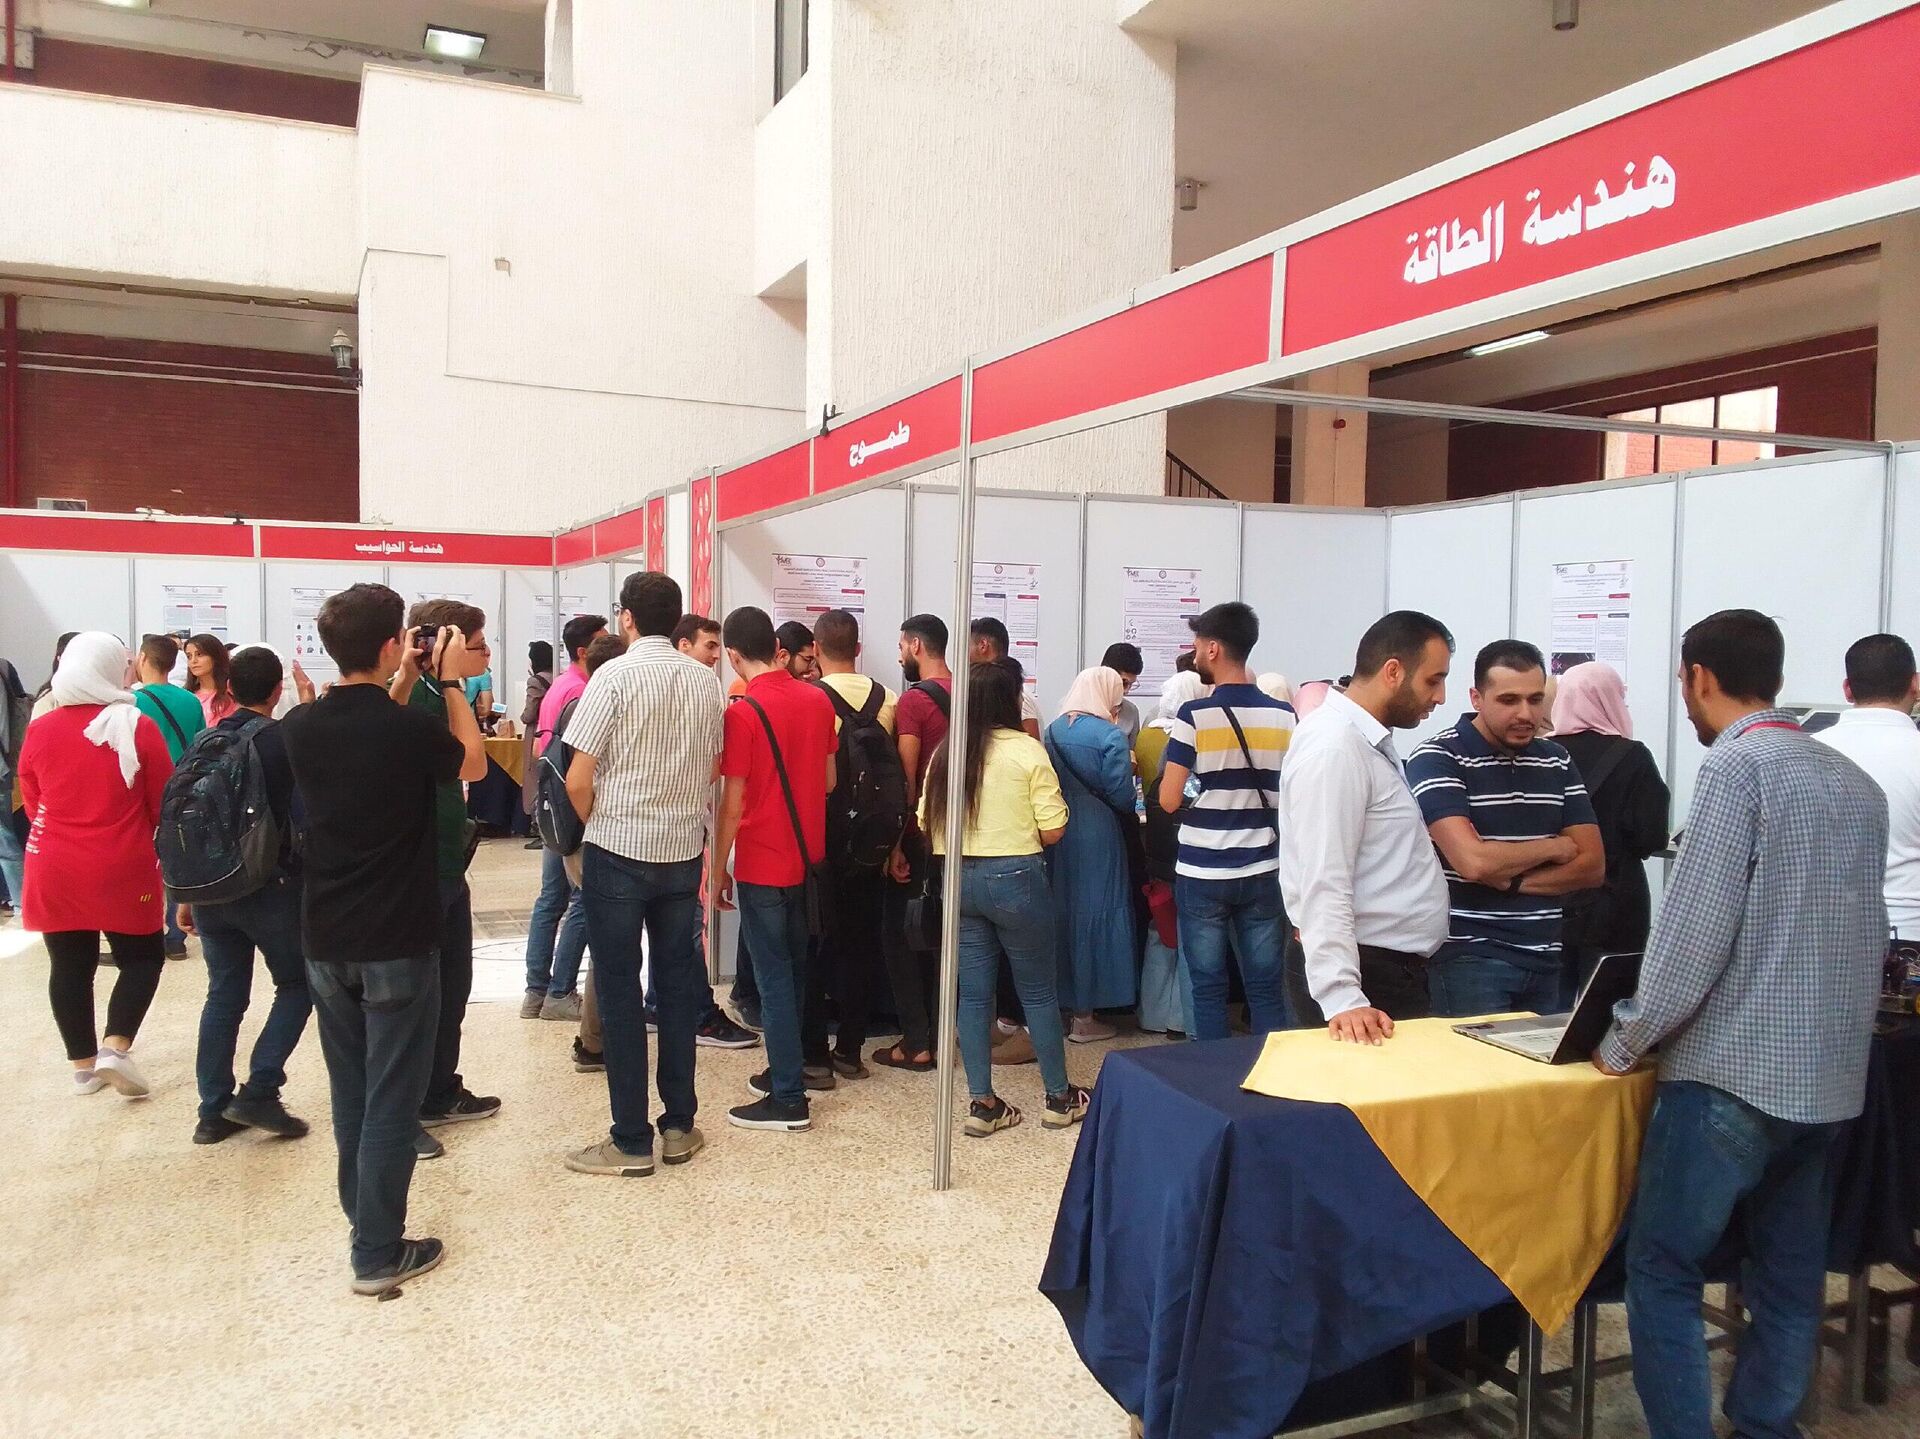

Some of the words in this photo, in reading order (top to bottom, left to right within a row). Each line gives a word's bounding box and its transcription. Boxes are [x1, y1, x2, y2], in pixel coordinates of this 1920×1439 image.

[1522, 154, 1677, 246] هندسة
[1402, 200, 1505, 285] الطاقة
[354, 540, 405, 555] الحواسيب
[408, 540, 444, 554] هندسة
